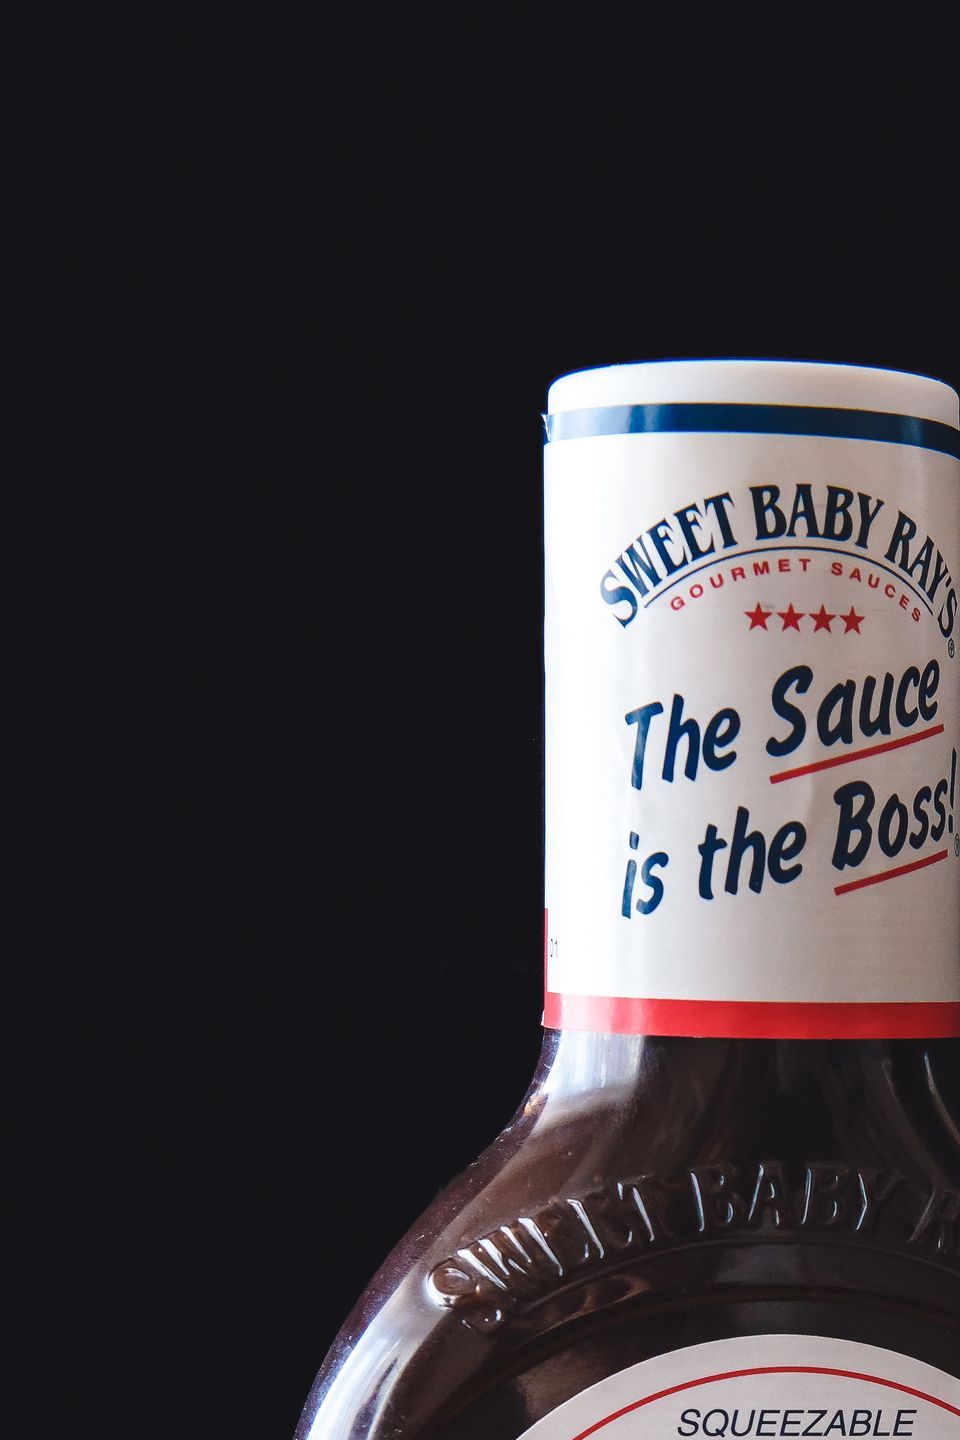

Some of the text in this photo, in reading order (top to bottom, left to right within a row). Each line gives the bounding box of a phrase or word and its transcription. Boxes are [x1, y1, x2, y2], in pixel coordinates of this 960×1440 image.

[600, 482, 958, 639] SWEET BABY RAY'S
[670, 558, 921, 622] GOURMET SAUCES
[625, 658, 941, 791] The Sauce
[620, 747, 957, 919] is the Boss!
[688, 1160, 902, 1232] BABY
[677, 1408, 918, 1438] SQUEEZABLE
